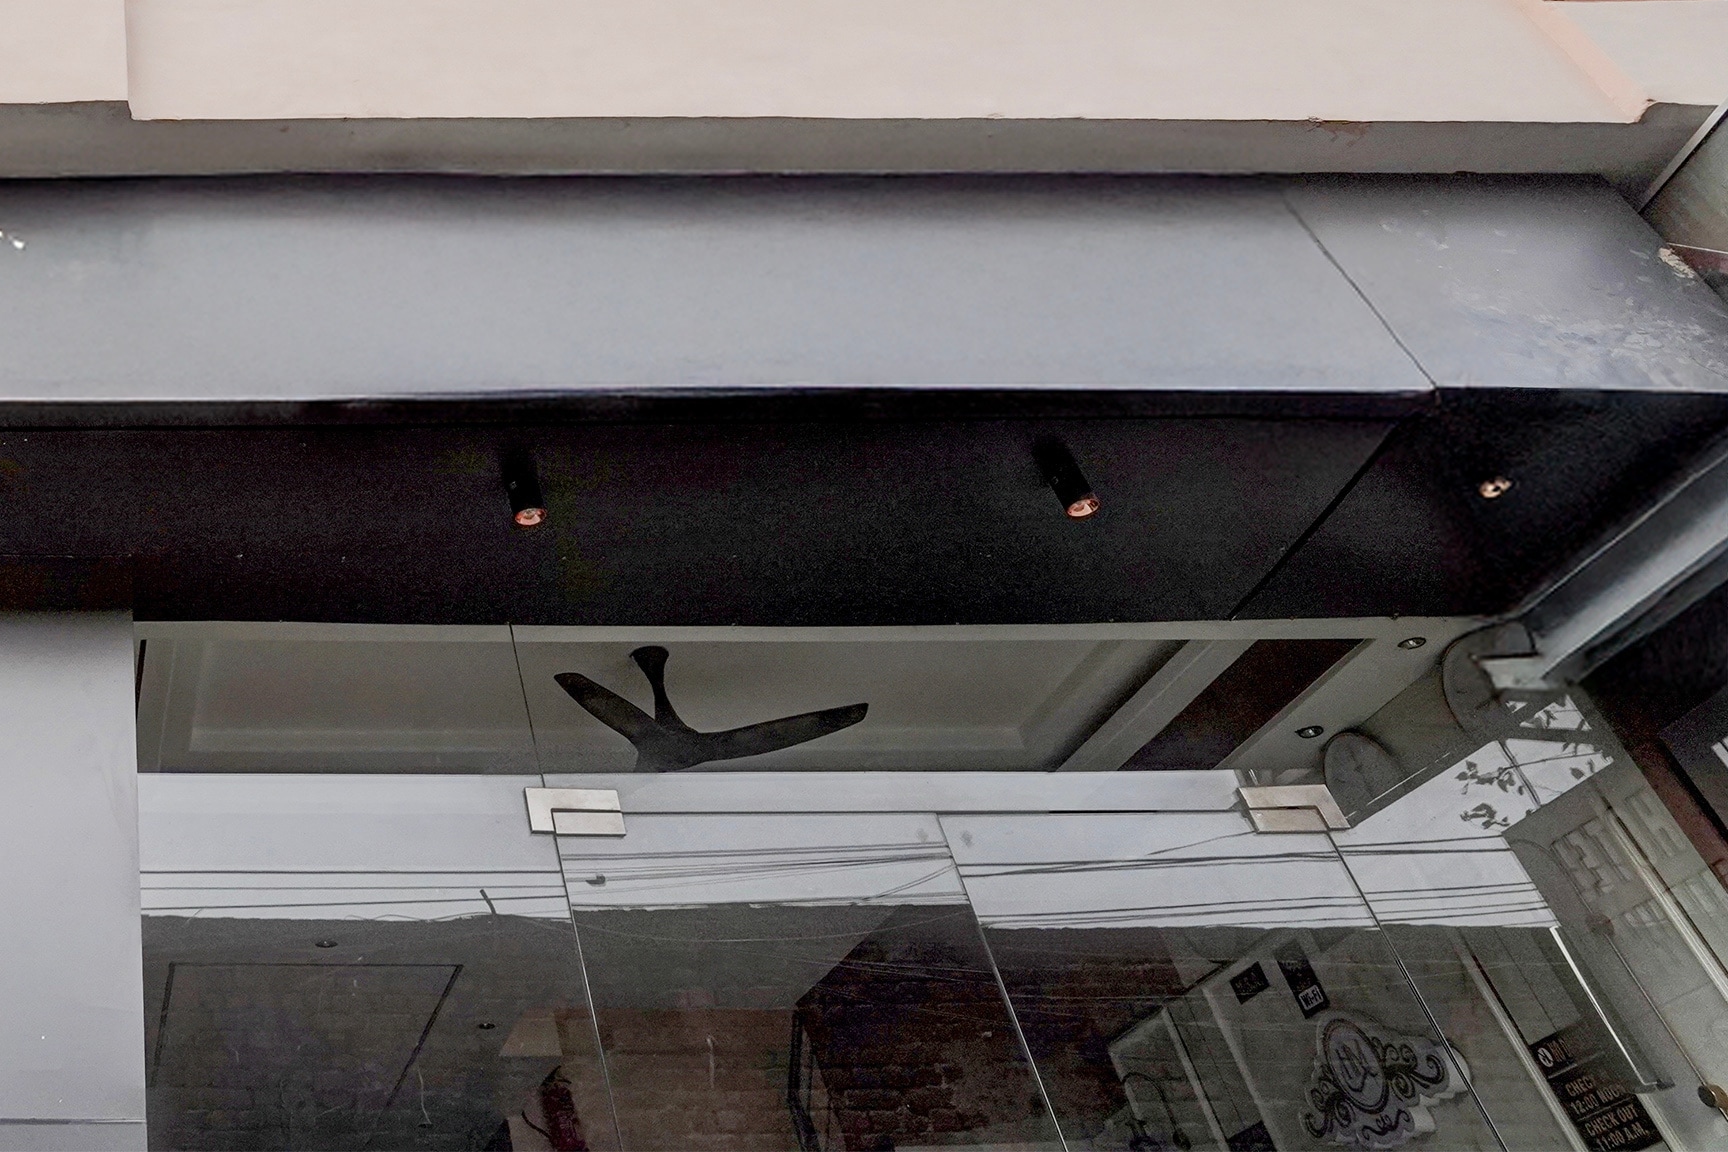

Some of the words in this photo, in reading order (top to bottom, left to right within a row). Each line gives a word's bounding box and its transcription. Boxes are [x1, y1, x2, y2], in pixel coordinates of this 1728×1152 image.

[1570, 1093, 1599, 1115] 12:00
[1585, 1111, 1620, 1137] CHECK
[1616, 1103, 1639, 1123] OUT
[1596, 1129, 1626, 1152] 11:00
[1623, 1121, 1650, 1141] A.M.
